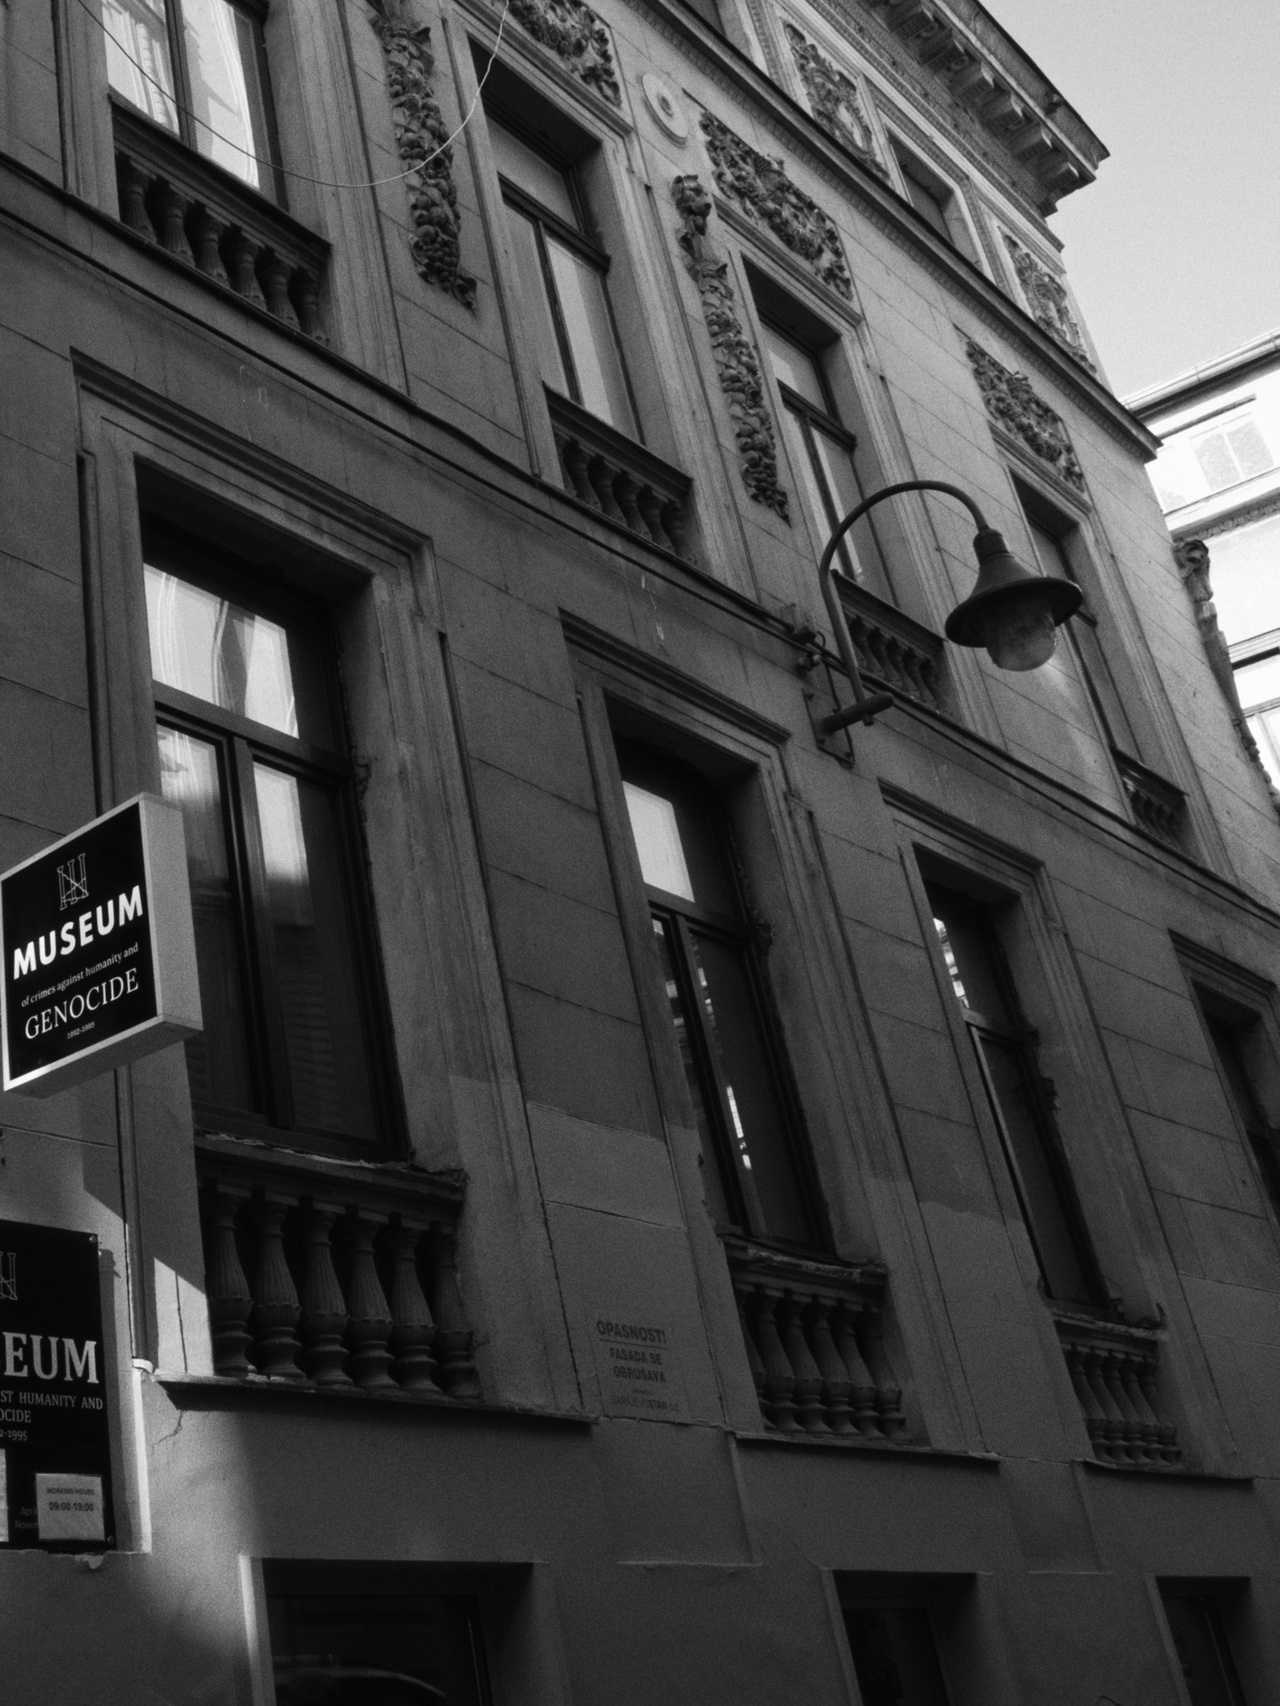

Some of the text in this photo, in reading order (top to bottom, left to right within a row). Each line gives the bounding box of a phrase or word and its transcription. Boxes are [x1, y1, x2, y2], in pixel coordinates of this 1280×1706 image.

[13, 885, 143, 980] MUSEUM
[21, 941, 139, 1007] of crimes against humanity and
[25, 967, 139, 1039] GENOCIDE
[66, 1021, 95, 1039] 1992-1995
[596, 1320, 667, 1344] OPASNOST!
[609, 1347, 663, 1365] FASADA SE
[613, 1365, 667, 1382] OBRUSAVA
[19, 1391, 77, 1408] HUMANITY
[81, 1396, 103, 1410] AND
[48, 1501, 94, 1512] 09:00-19:00
